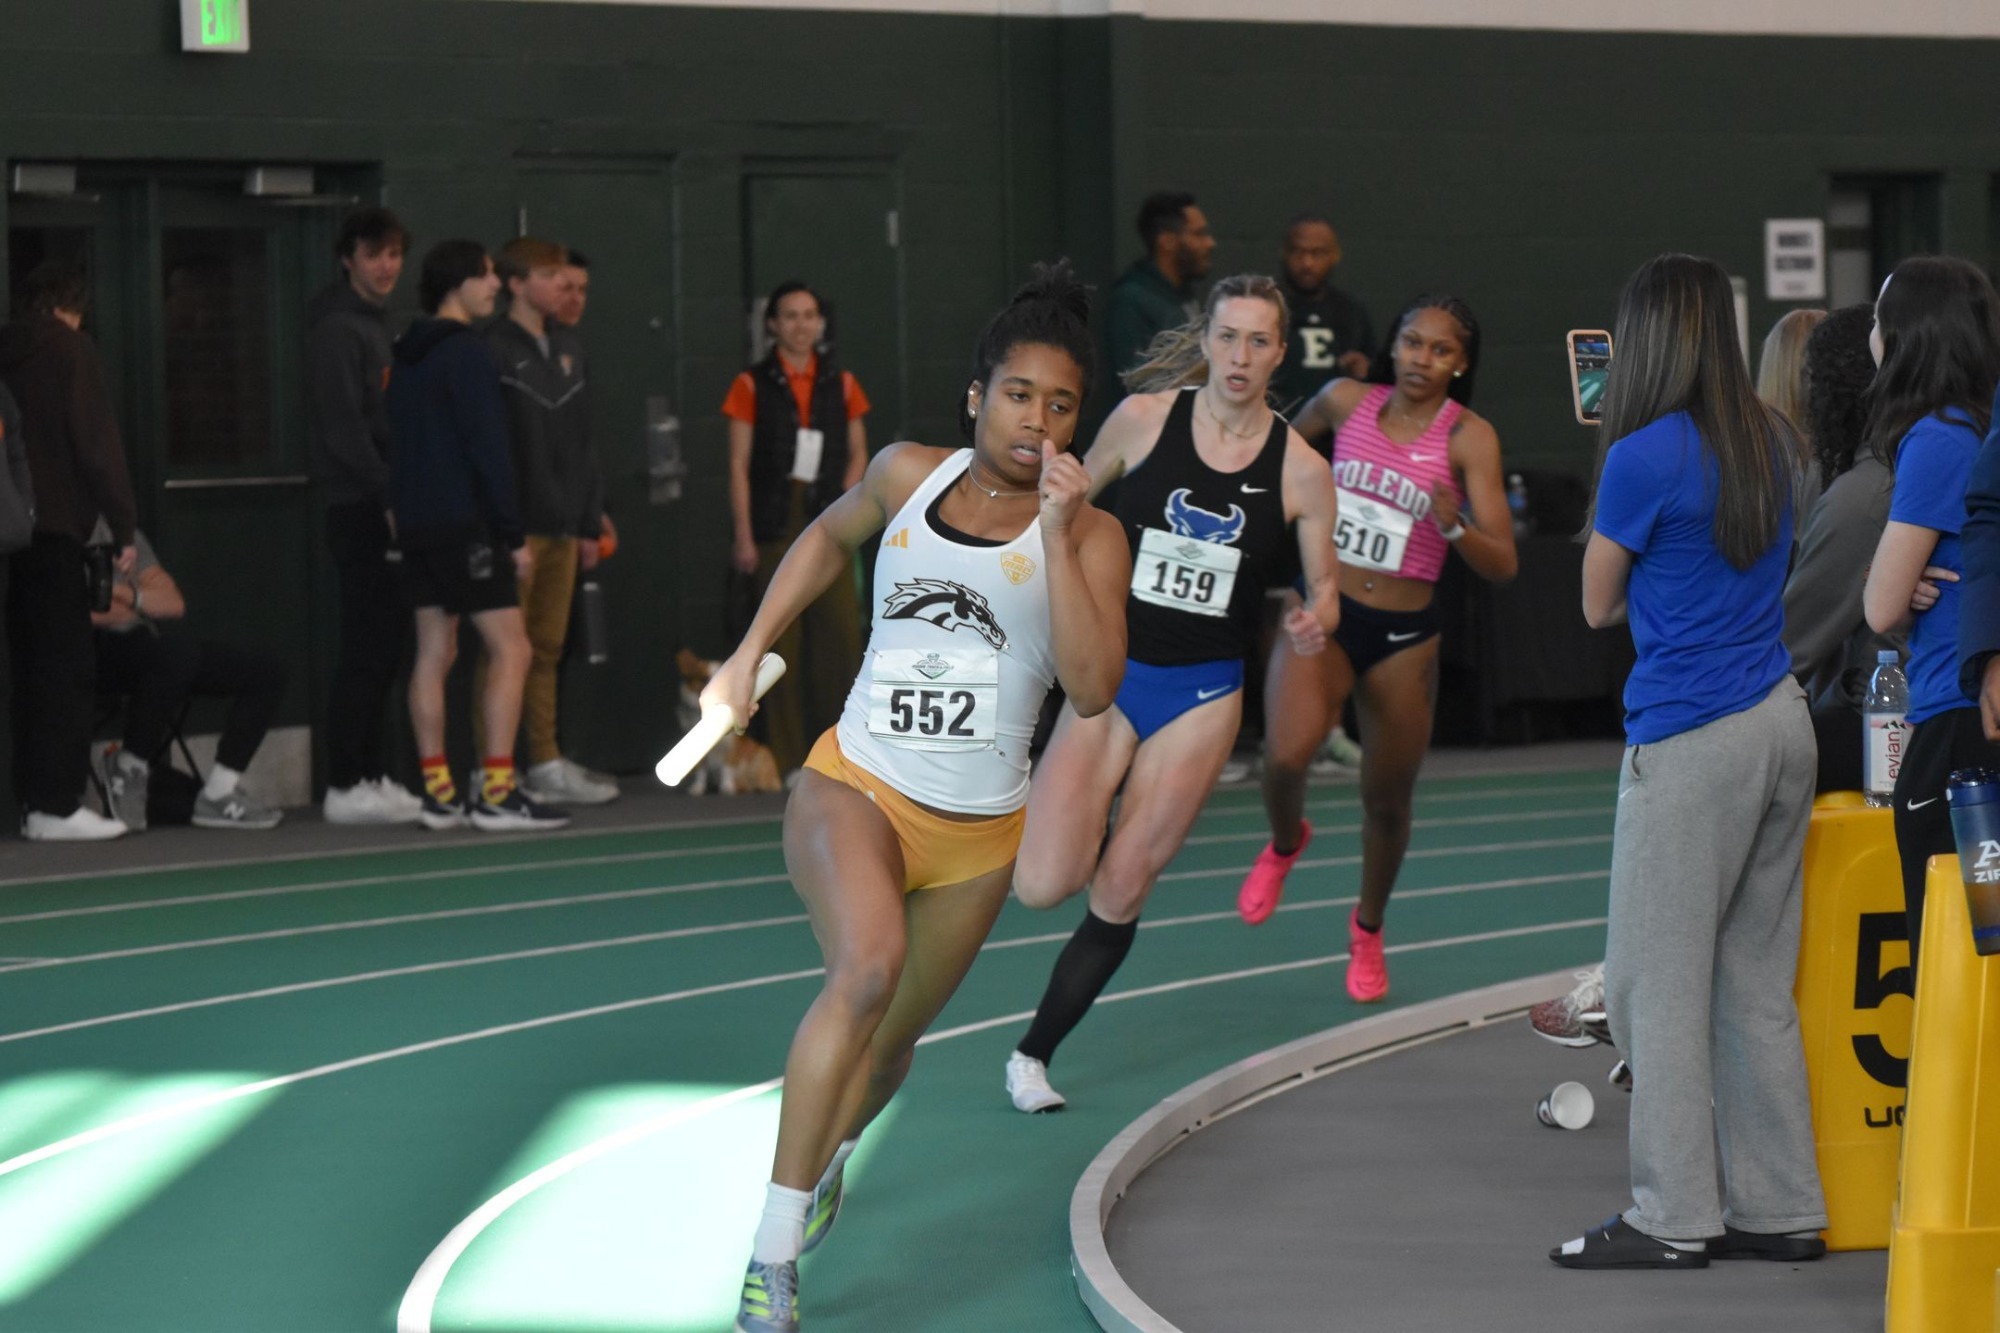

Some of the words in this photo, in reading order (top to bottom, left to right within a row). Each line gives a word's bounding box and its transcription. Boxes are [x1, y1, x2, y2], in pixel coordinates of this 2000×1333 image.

[1298, 327, 1336, 369] E
[1335, 519, 1390, 563] 510
[1151, 560, 1216, 604] 159
[889, 689, 976, 737] 552
[1885, 731, 1902, 780] evian
[1851, 912, 1916, 1088] 5
